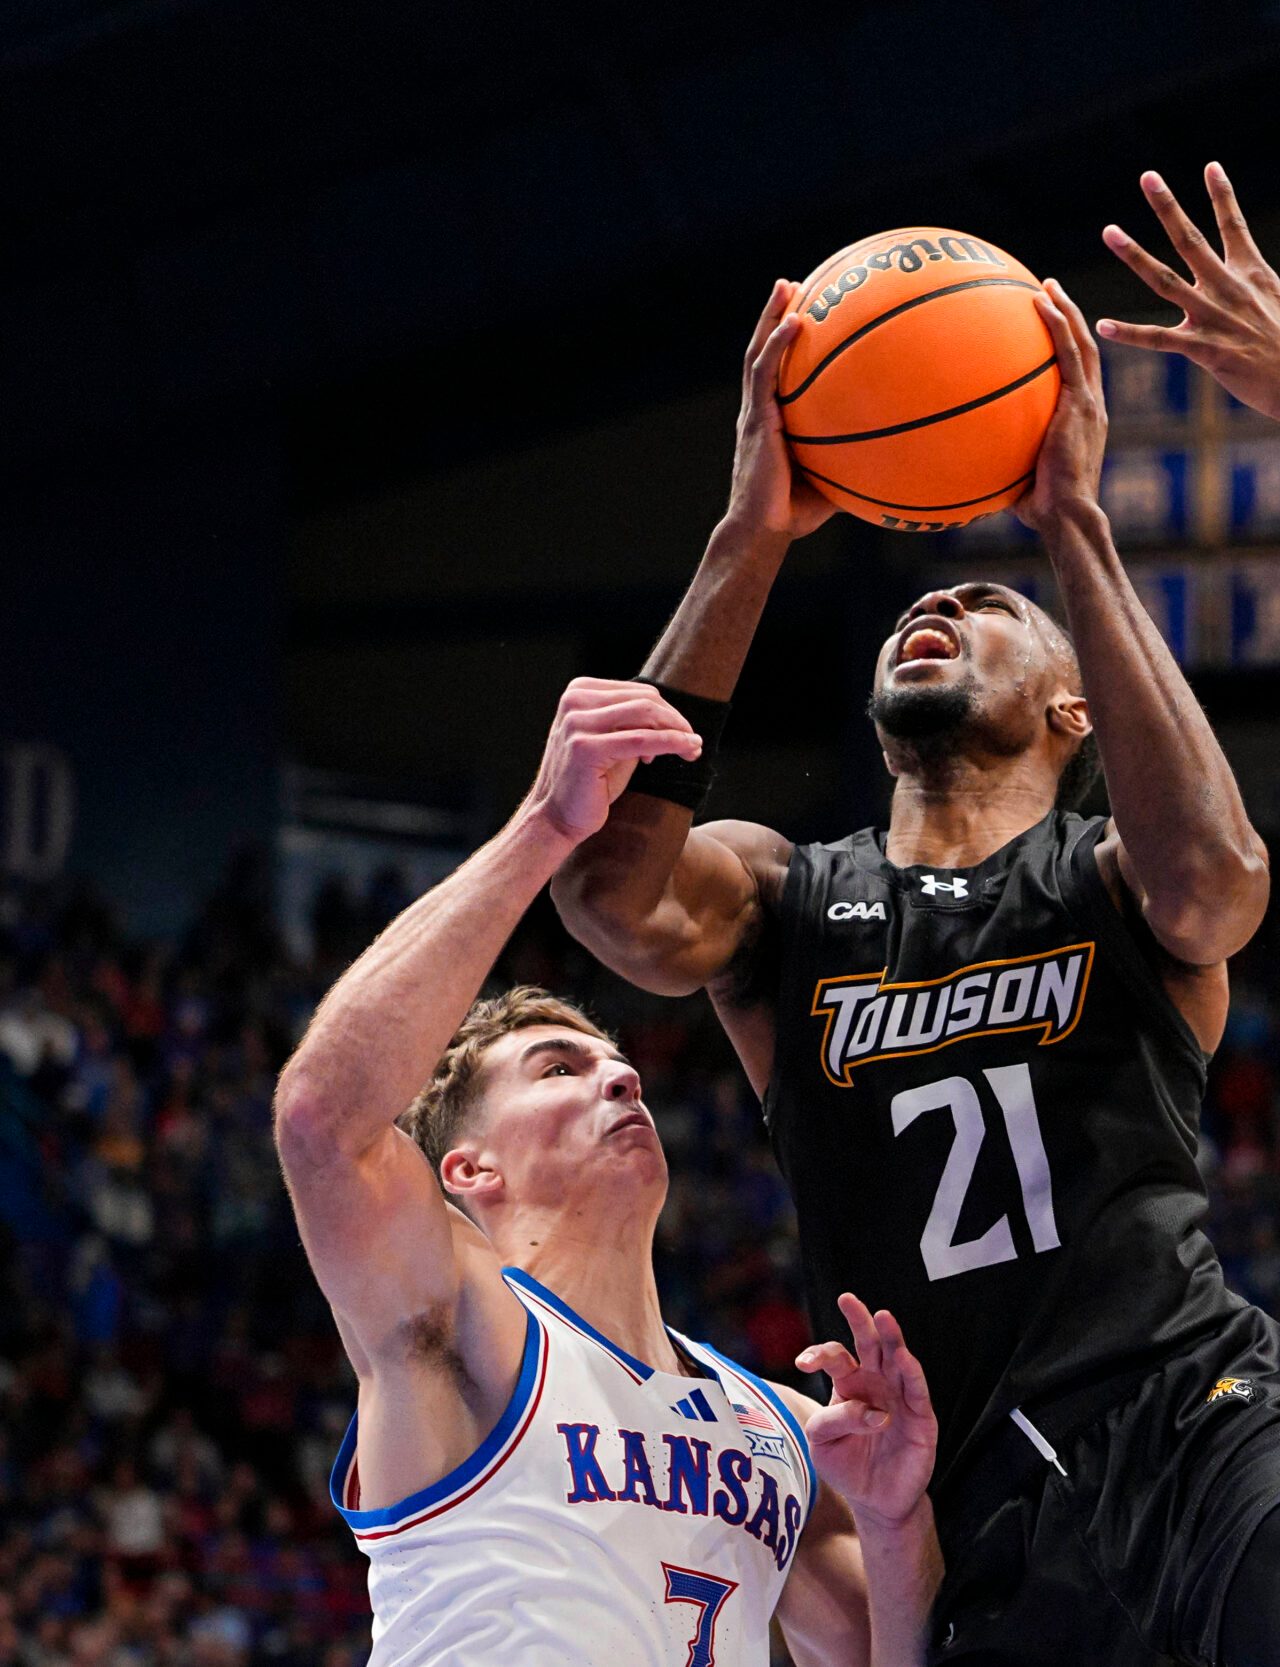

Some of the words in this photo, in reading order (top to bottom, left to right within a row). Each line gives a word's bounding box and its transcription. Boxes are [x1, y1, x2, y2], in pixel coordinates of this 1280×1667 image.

[807, 236, 1007, 324] Wilson
[827, 901, 887, 921] CAA
[819, 950, 1088, 1081] TOWSON
[890, 1062, 1062, 1282] 21
[556, 1422, 801, 1572] KANSAS
[660, 1560, 740, 1667] 7
